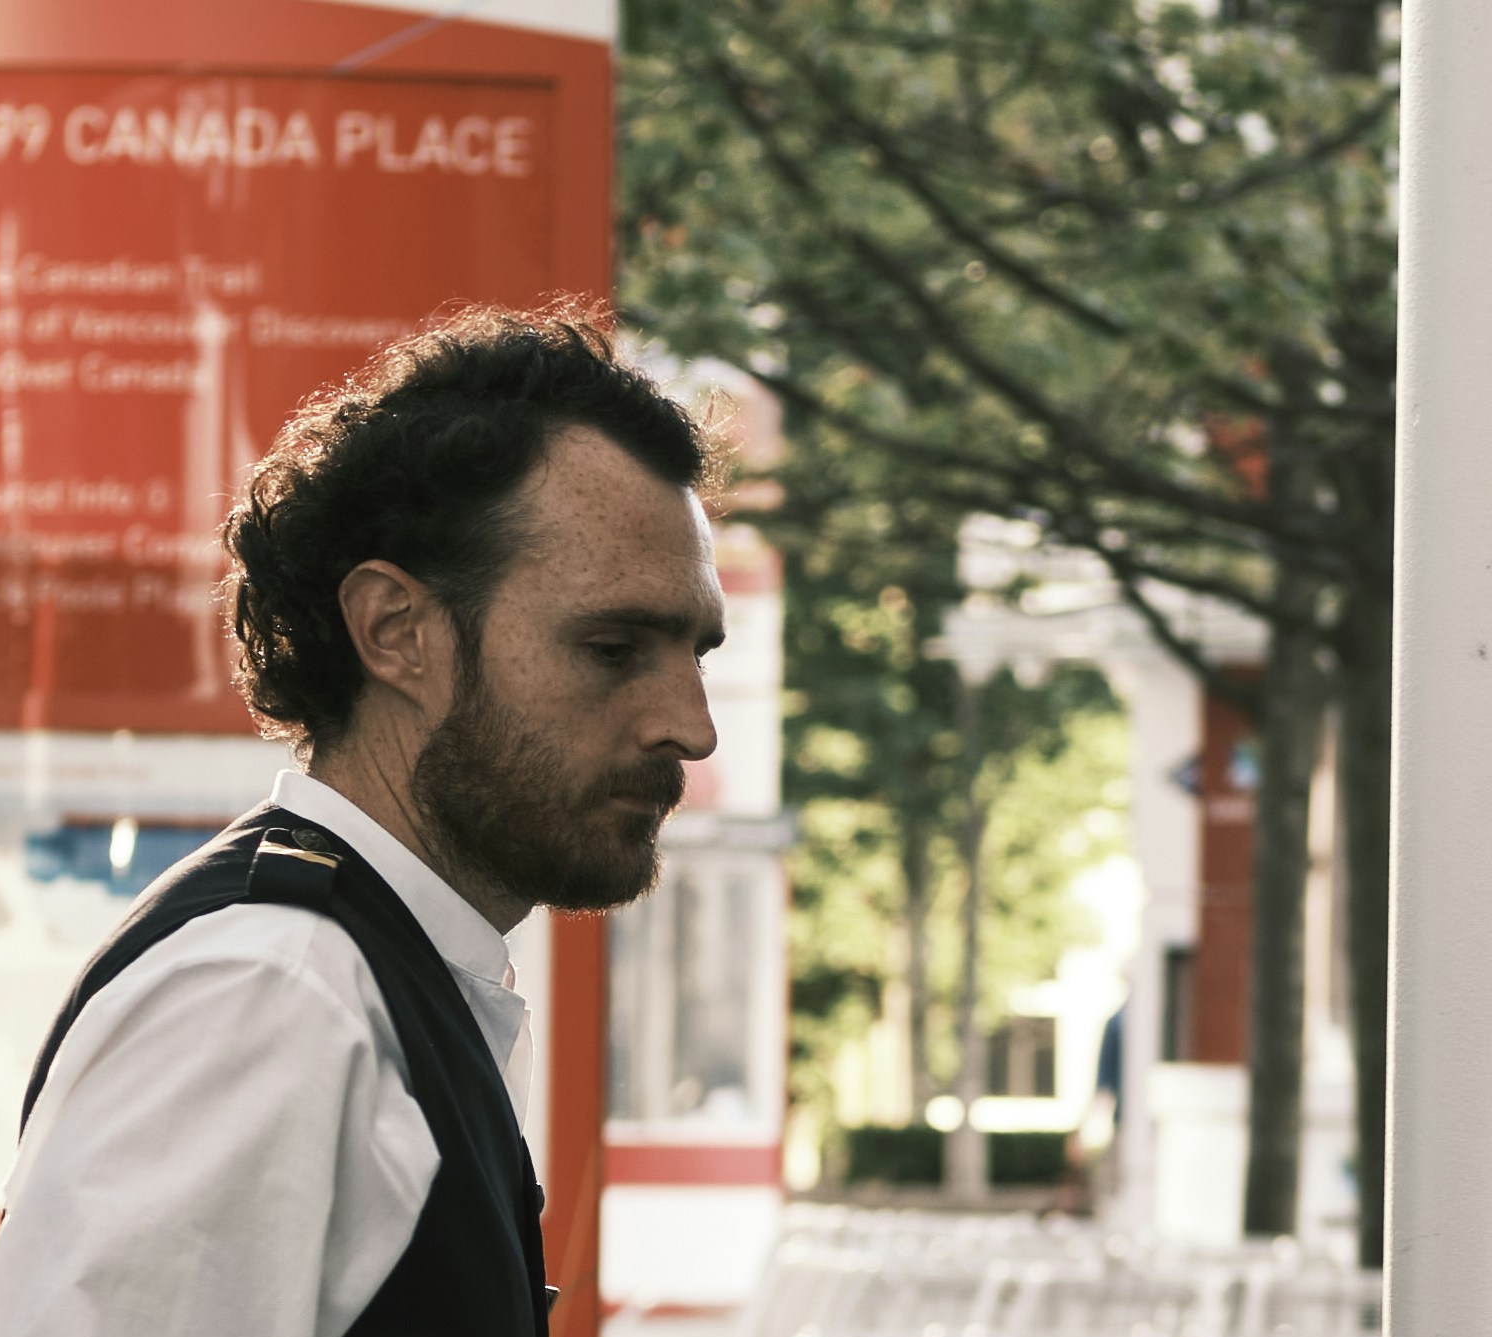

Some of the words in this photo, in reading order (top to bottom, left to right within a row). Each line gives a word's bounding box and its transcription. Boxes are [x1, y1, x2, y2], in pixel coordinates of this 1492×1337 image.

[63, 105, 319, 169] CANADA
[335, 110, 535, 177] PLACE
[19, 253, 174, 293] Canadian
